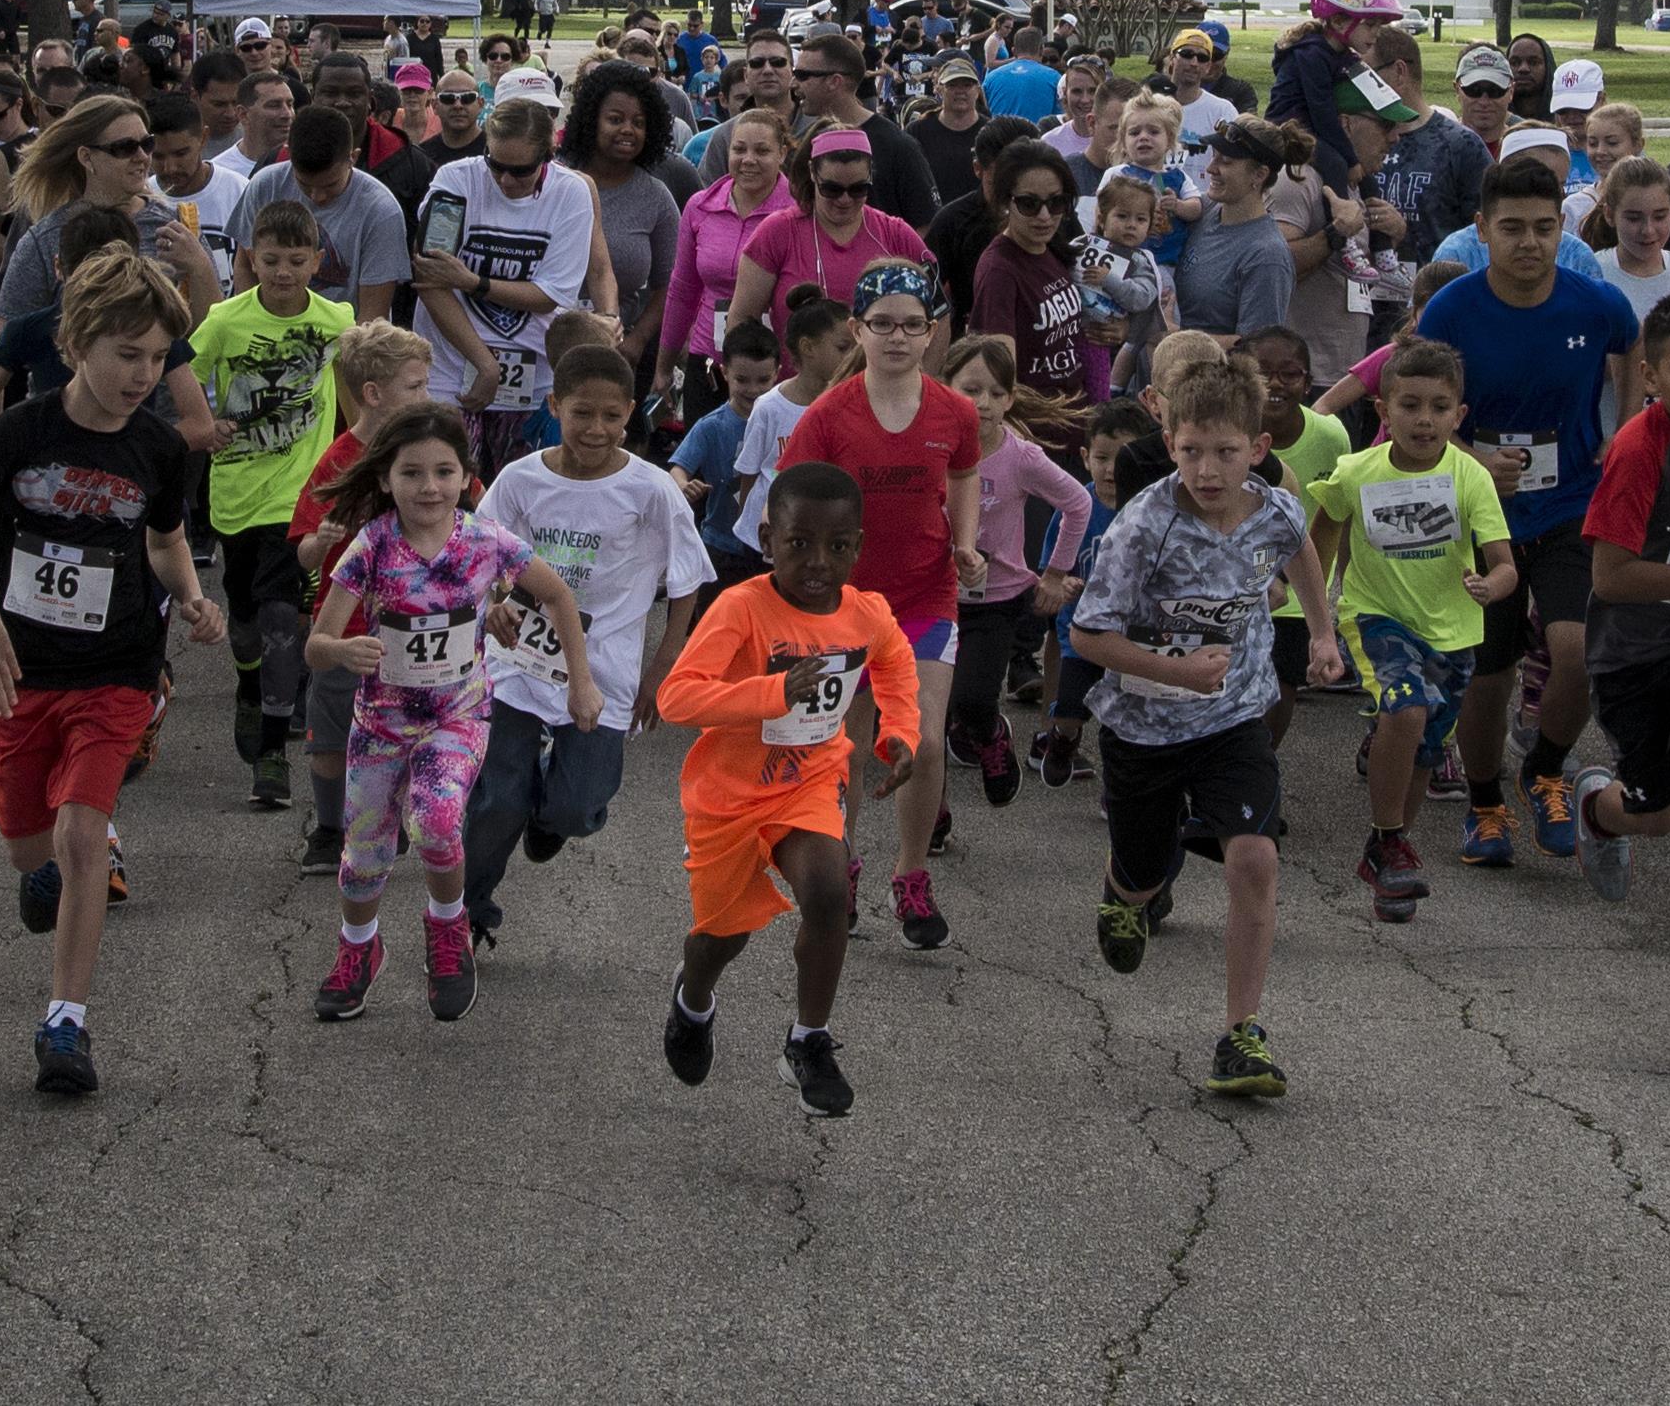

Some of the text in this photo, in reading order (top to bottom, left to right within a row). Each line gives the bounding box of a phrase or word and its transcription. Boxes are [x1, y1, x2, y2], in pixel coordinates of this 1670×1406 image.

[489, 257, 523, 280] KID
[1033, 284, 1082, 330] JAGU
[1044, 318, 1081, 346] alwa
[231, 412, 316, 453] SAVAGE
[558, 529, 602, 551] NEEDS
[34, 561, 81, 600] 46
[567, 564, 592, 580] HAVE
[405, 630, 451, 663] 47
[798, 675, 844, 716] 49
